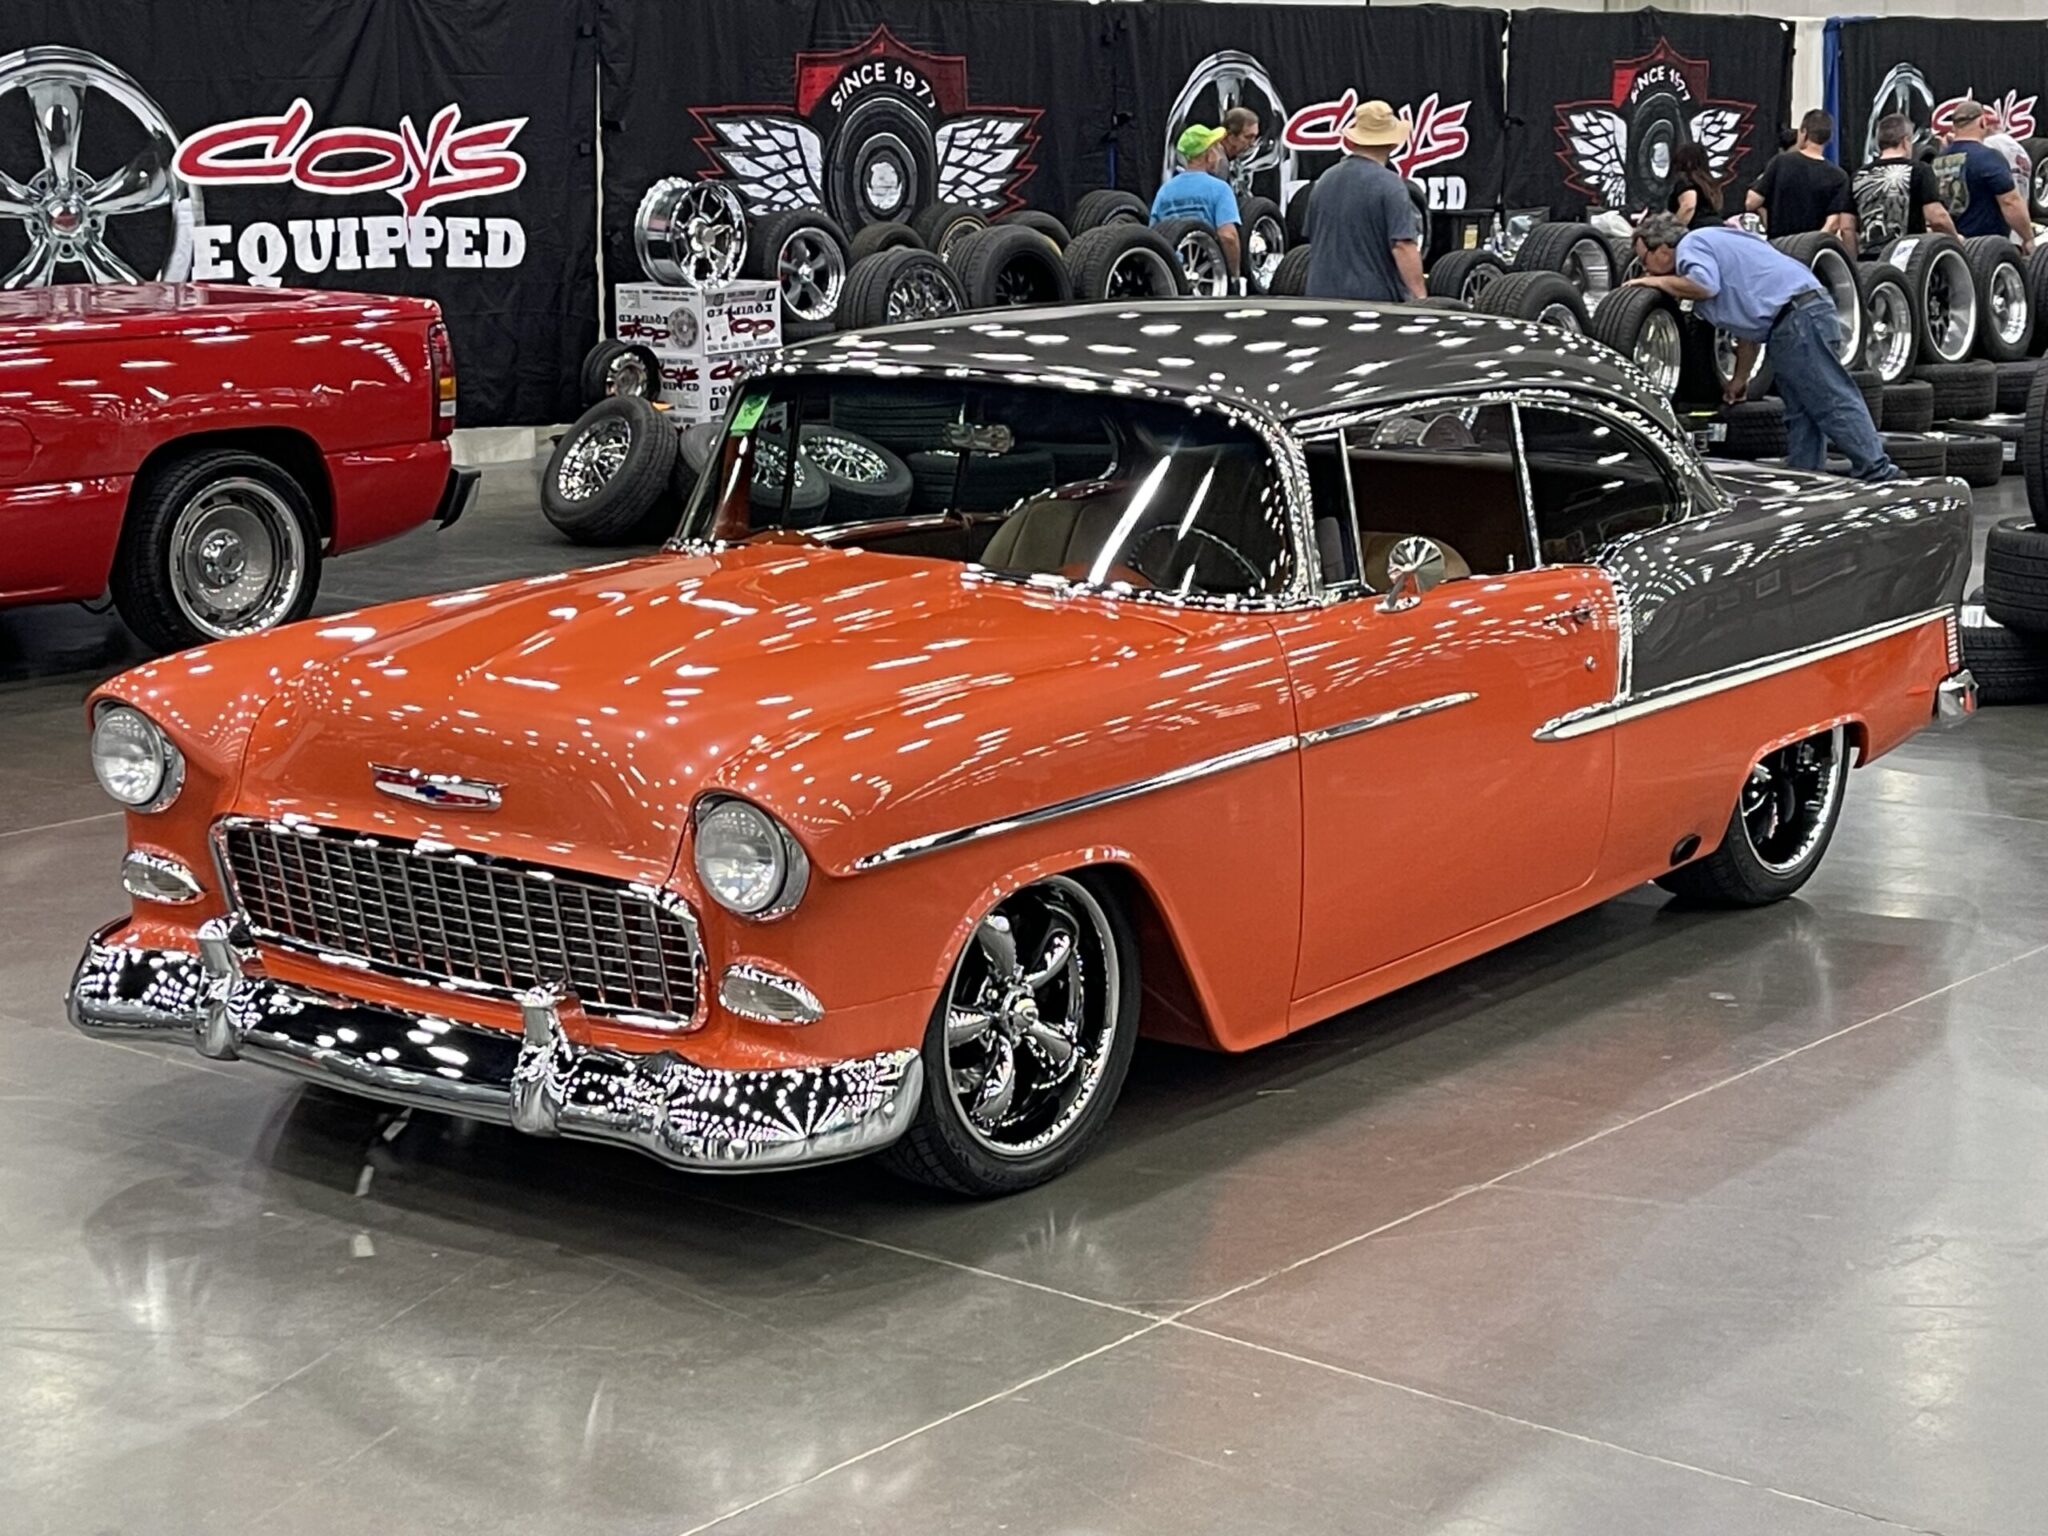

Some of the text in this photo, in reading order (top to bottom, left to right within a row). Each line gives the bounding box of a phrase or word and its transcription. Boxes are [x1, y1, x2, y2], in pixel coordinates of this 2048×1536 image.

[830, 62, 886, 113] SINCE
[1283, 87, 1473, 180] CYS
[190, 214, 527, 288] EQUIPPED
